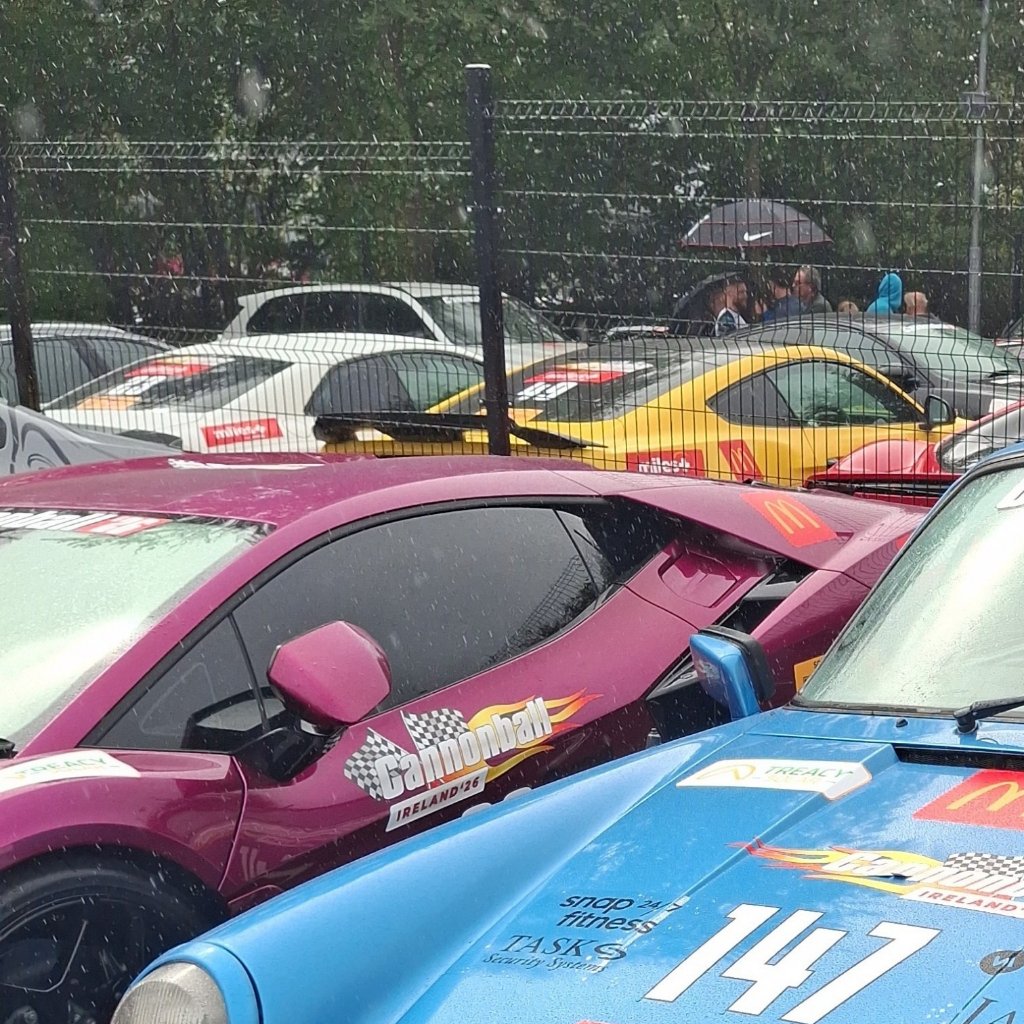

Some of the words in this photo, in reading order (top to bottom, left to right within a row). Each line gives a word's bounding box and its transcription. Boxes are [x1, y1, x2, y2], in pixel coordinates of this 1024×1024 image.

[374, 697, 552, 800] Cannonball
[765, 765, 854, 778] TREACY
[396, 776, 480, 822] IRELAND'26
[559, 895, 634, 914] snap
[637, 900, 683, 917] 24/7
[556, 910, 659, 934] fitness
[483, 952, 547, 968] Security
[547, 956, 608, 973] Systems
